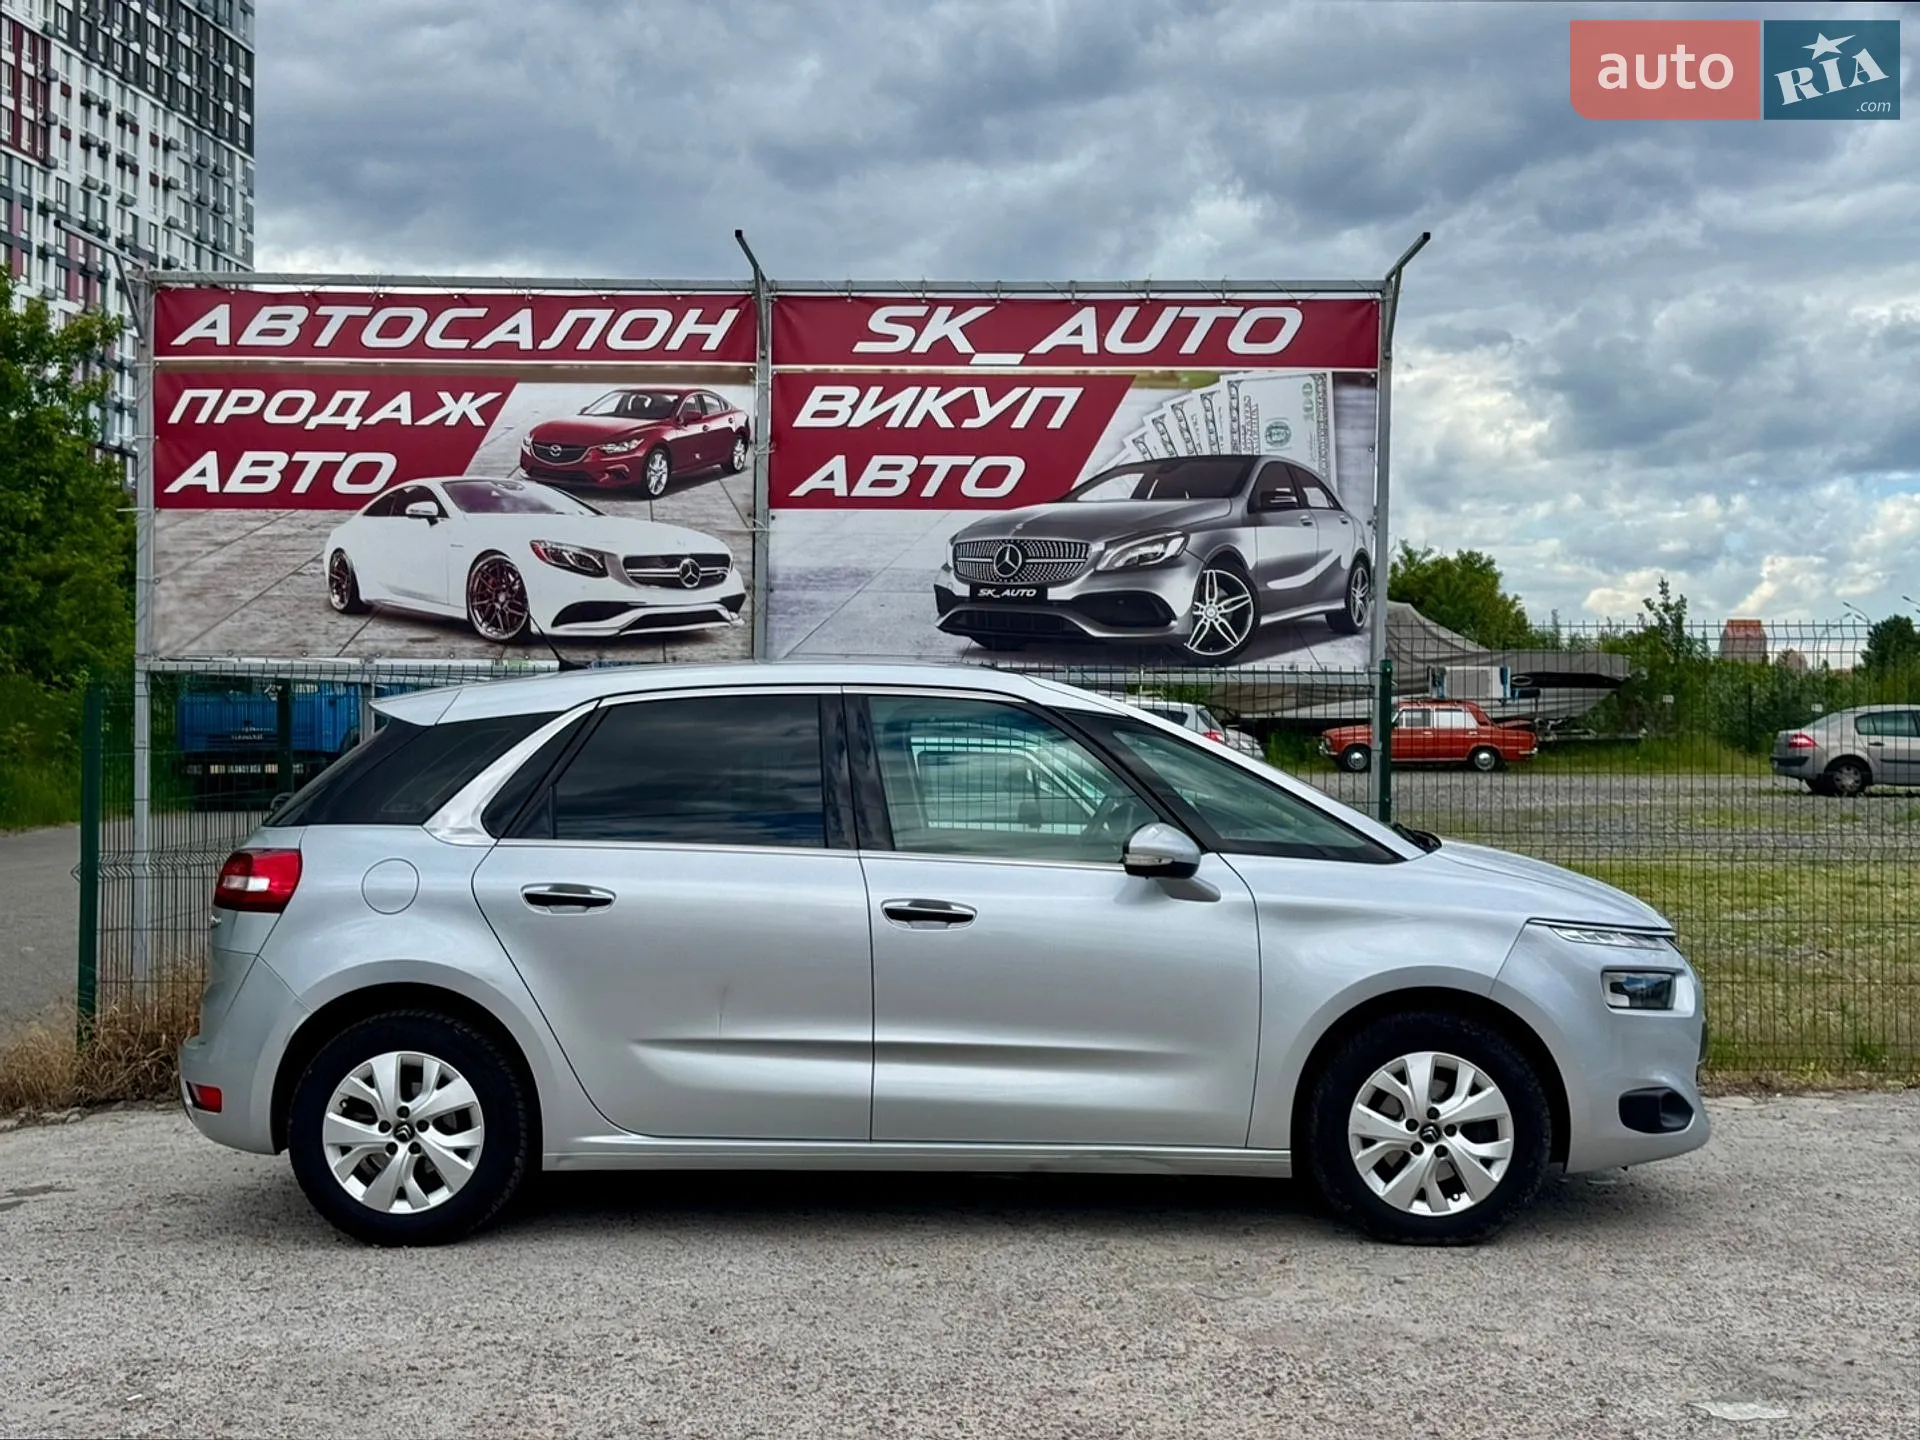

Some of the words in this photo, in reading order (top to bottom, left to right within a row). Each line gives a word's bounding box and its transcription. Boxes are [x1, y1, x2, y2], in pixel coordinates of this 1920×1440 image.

[170, 303, 740, 351] АВТОСАЛОН
[852, 305, 1303, 366] SK_AUTO
[167, 389, 502, 431] ПРОДАЖ
[792, 385, 1084, 429] ВИКУП
[164, 450, 397, 494] АВТО
[789, 454, 1026, 498] АВТО
[977, 588, 1037, 598] SK_AUTO
